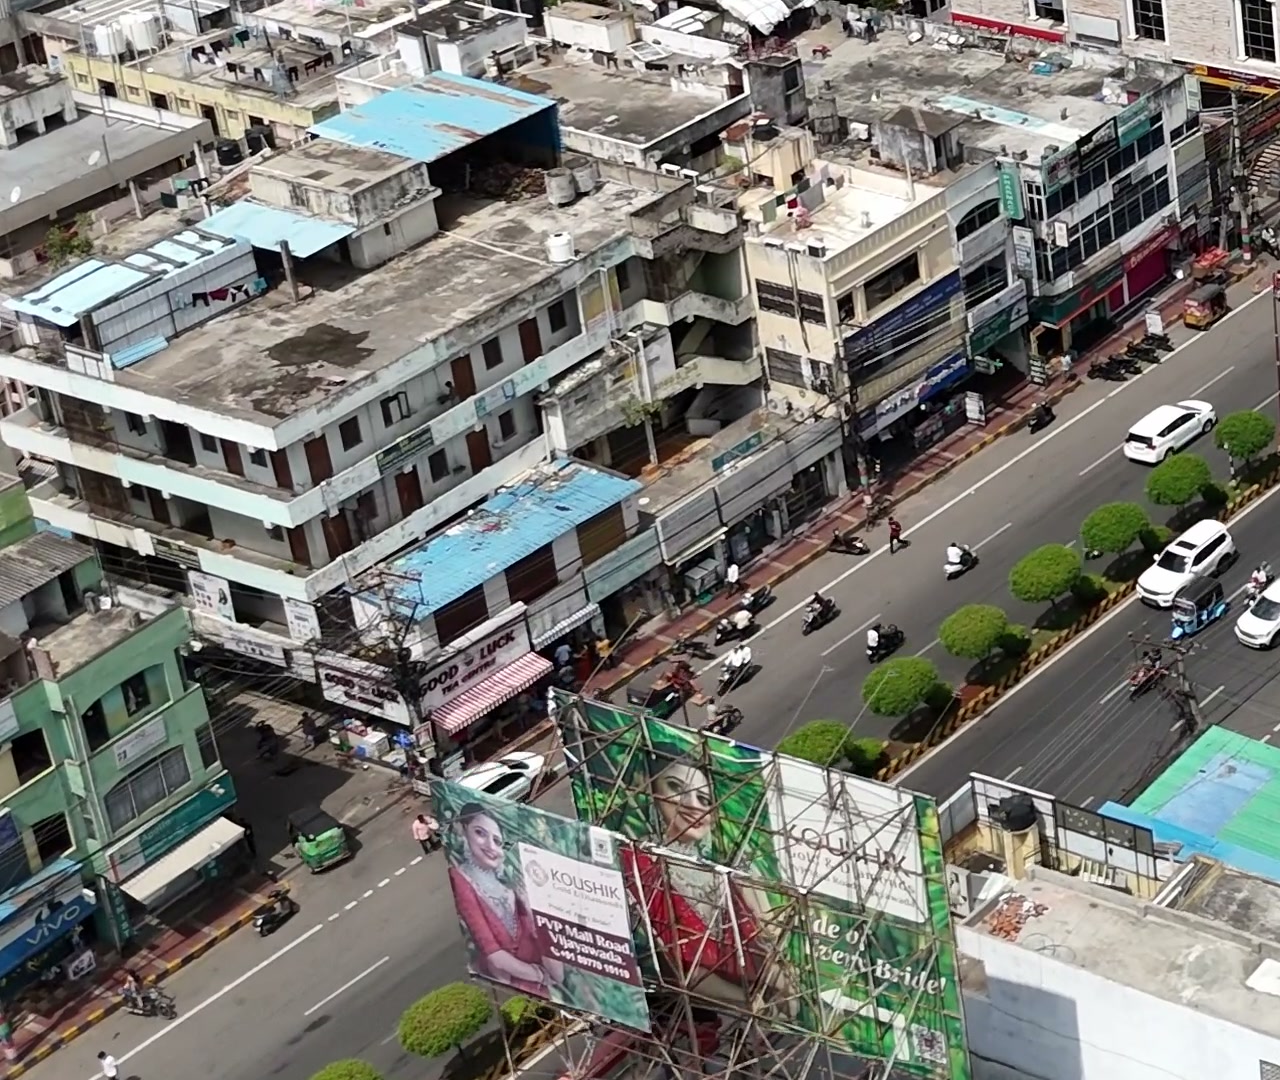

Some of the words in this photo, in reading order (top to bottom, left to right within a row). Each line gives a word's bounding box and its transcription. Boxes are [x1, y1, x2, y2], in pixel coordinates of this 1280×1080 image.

[420, 664, 460, 698] GOOD
[479, 629, 516, 660] LUCK
[550, 867, 622, 901] KOUSHIK
[26, 905, 80, 945] vivo
[536, 915, 564, 932] PVP
[564, 924, 595, 945] Mall
[547, 930, 627, 966] Vijayawada.
[873, 958, 947, 997] Bride!
